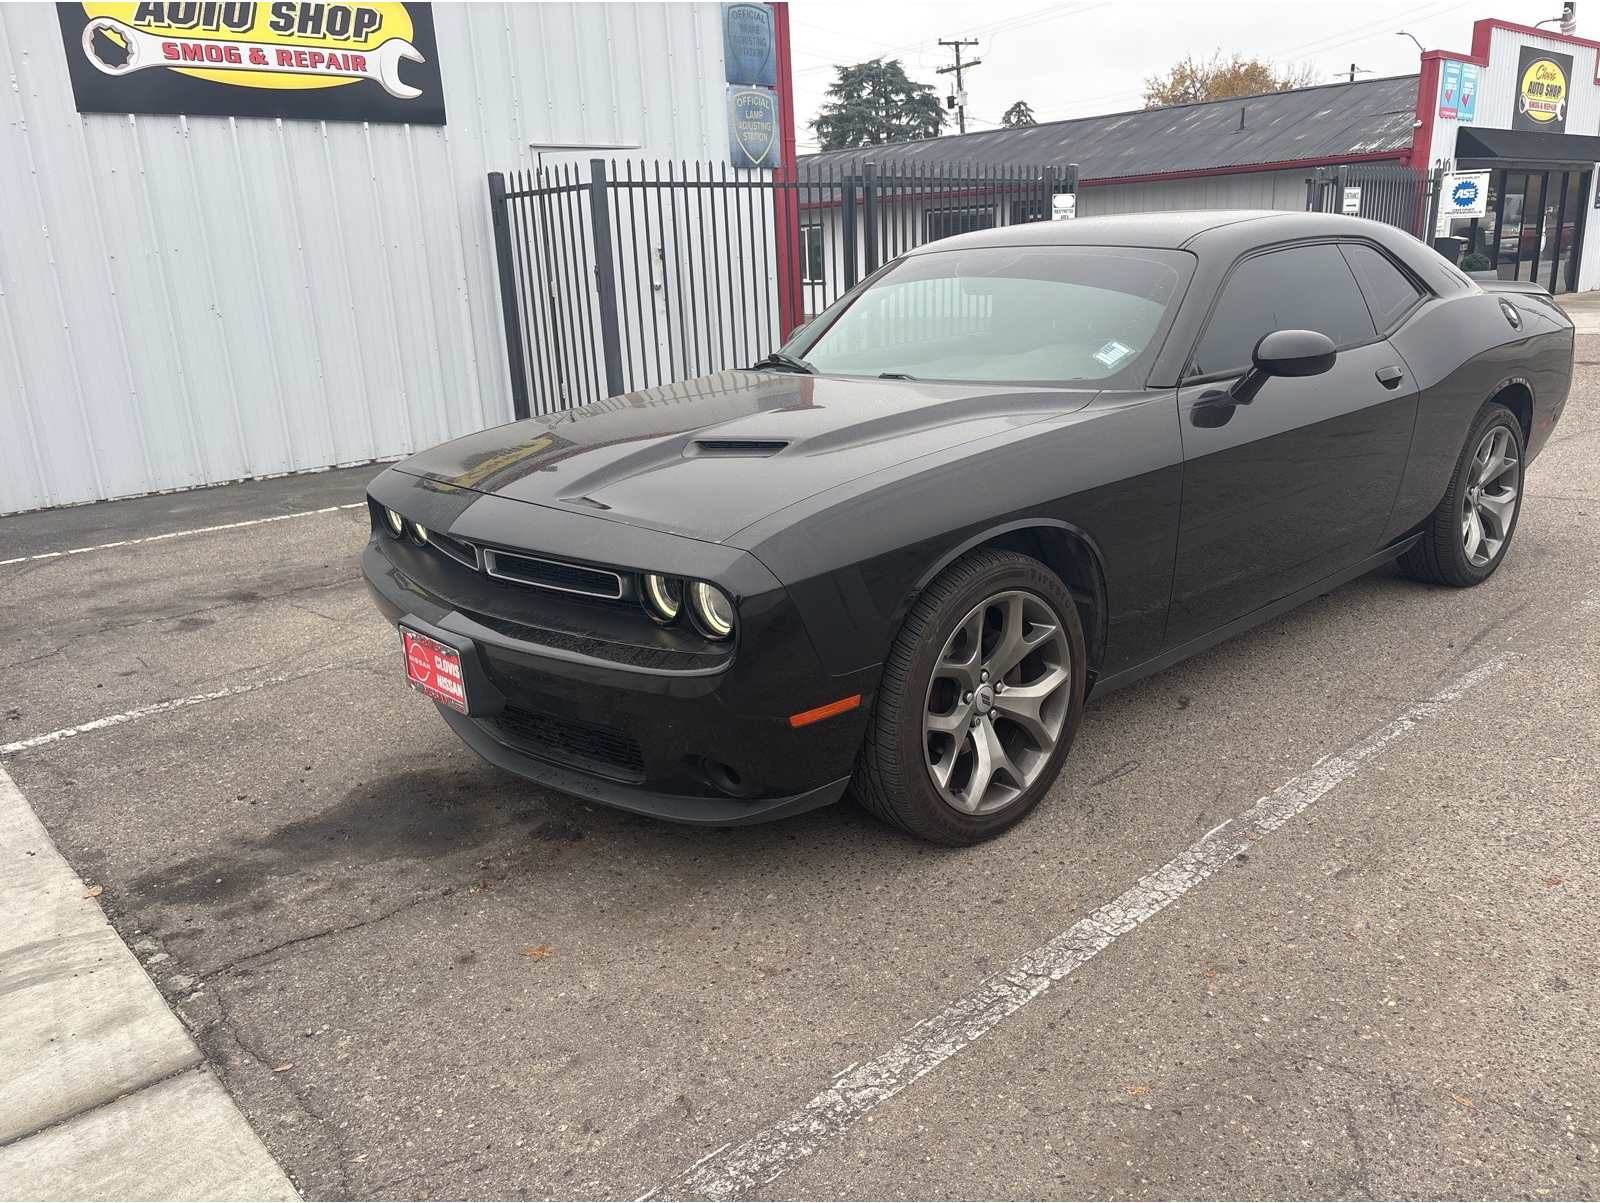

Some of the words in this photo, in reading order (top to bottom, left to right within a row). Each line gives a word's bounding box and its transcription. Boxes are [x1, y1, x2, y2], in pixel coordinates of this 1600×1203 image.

[269, 2, 383, 43] SHOP
[731, 7, 766, 24] OFFICIAL
[162, 42, 242, 64] SMOG
[249, 47, 269, 66] &
[275, 48, 368, 72] REPAIR
[1527, 81, 1544, 97] AUTO
[1545, 84, 1562, 99] SHOP
[736, 96, 770, 109] OFFICIAL
[745, 111, 763, 119] LAMP
[738, 121, 771, 131] ADJUSTING
[1455, 188, 1476, 199] ASE
[408, 654, 431, 670] NISSAN
[434, 655, 460, 679] CLOVIS
[436, 673, 464, 699] NISSAN
